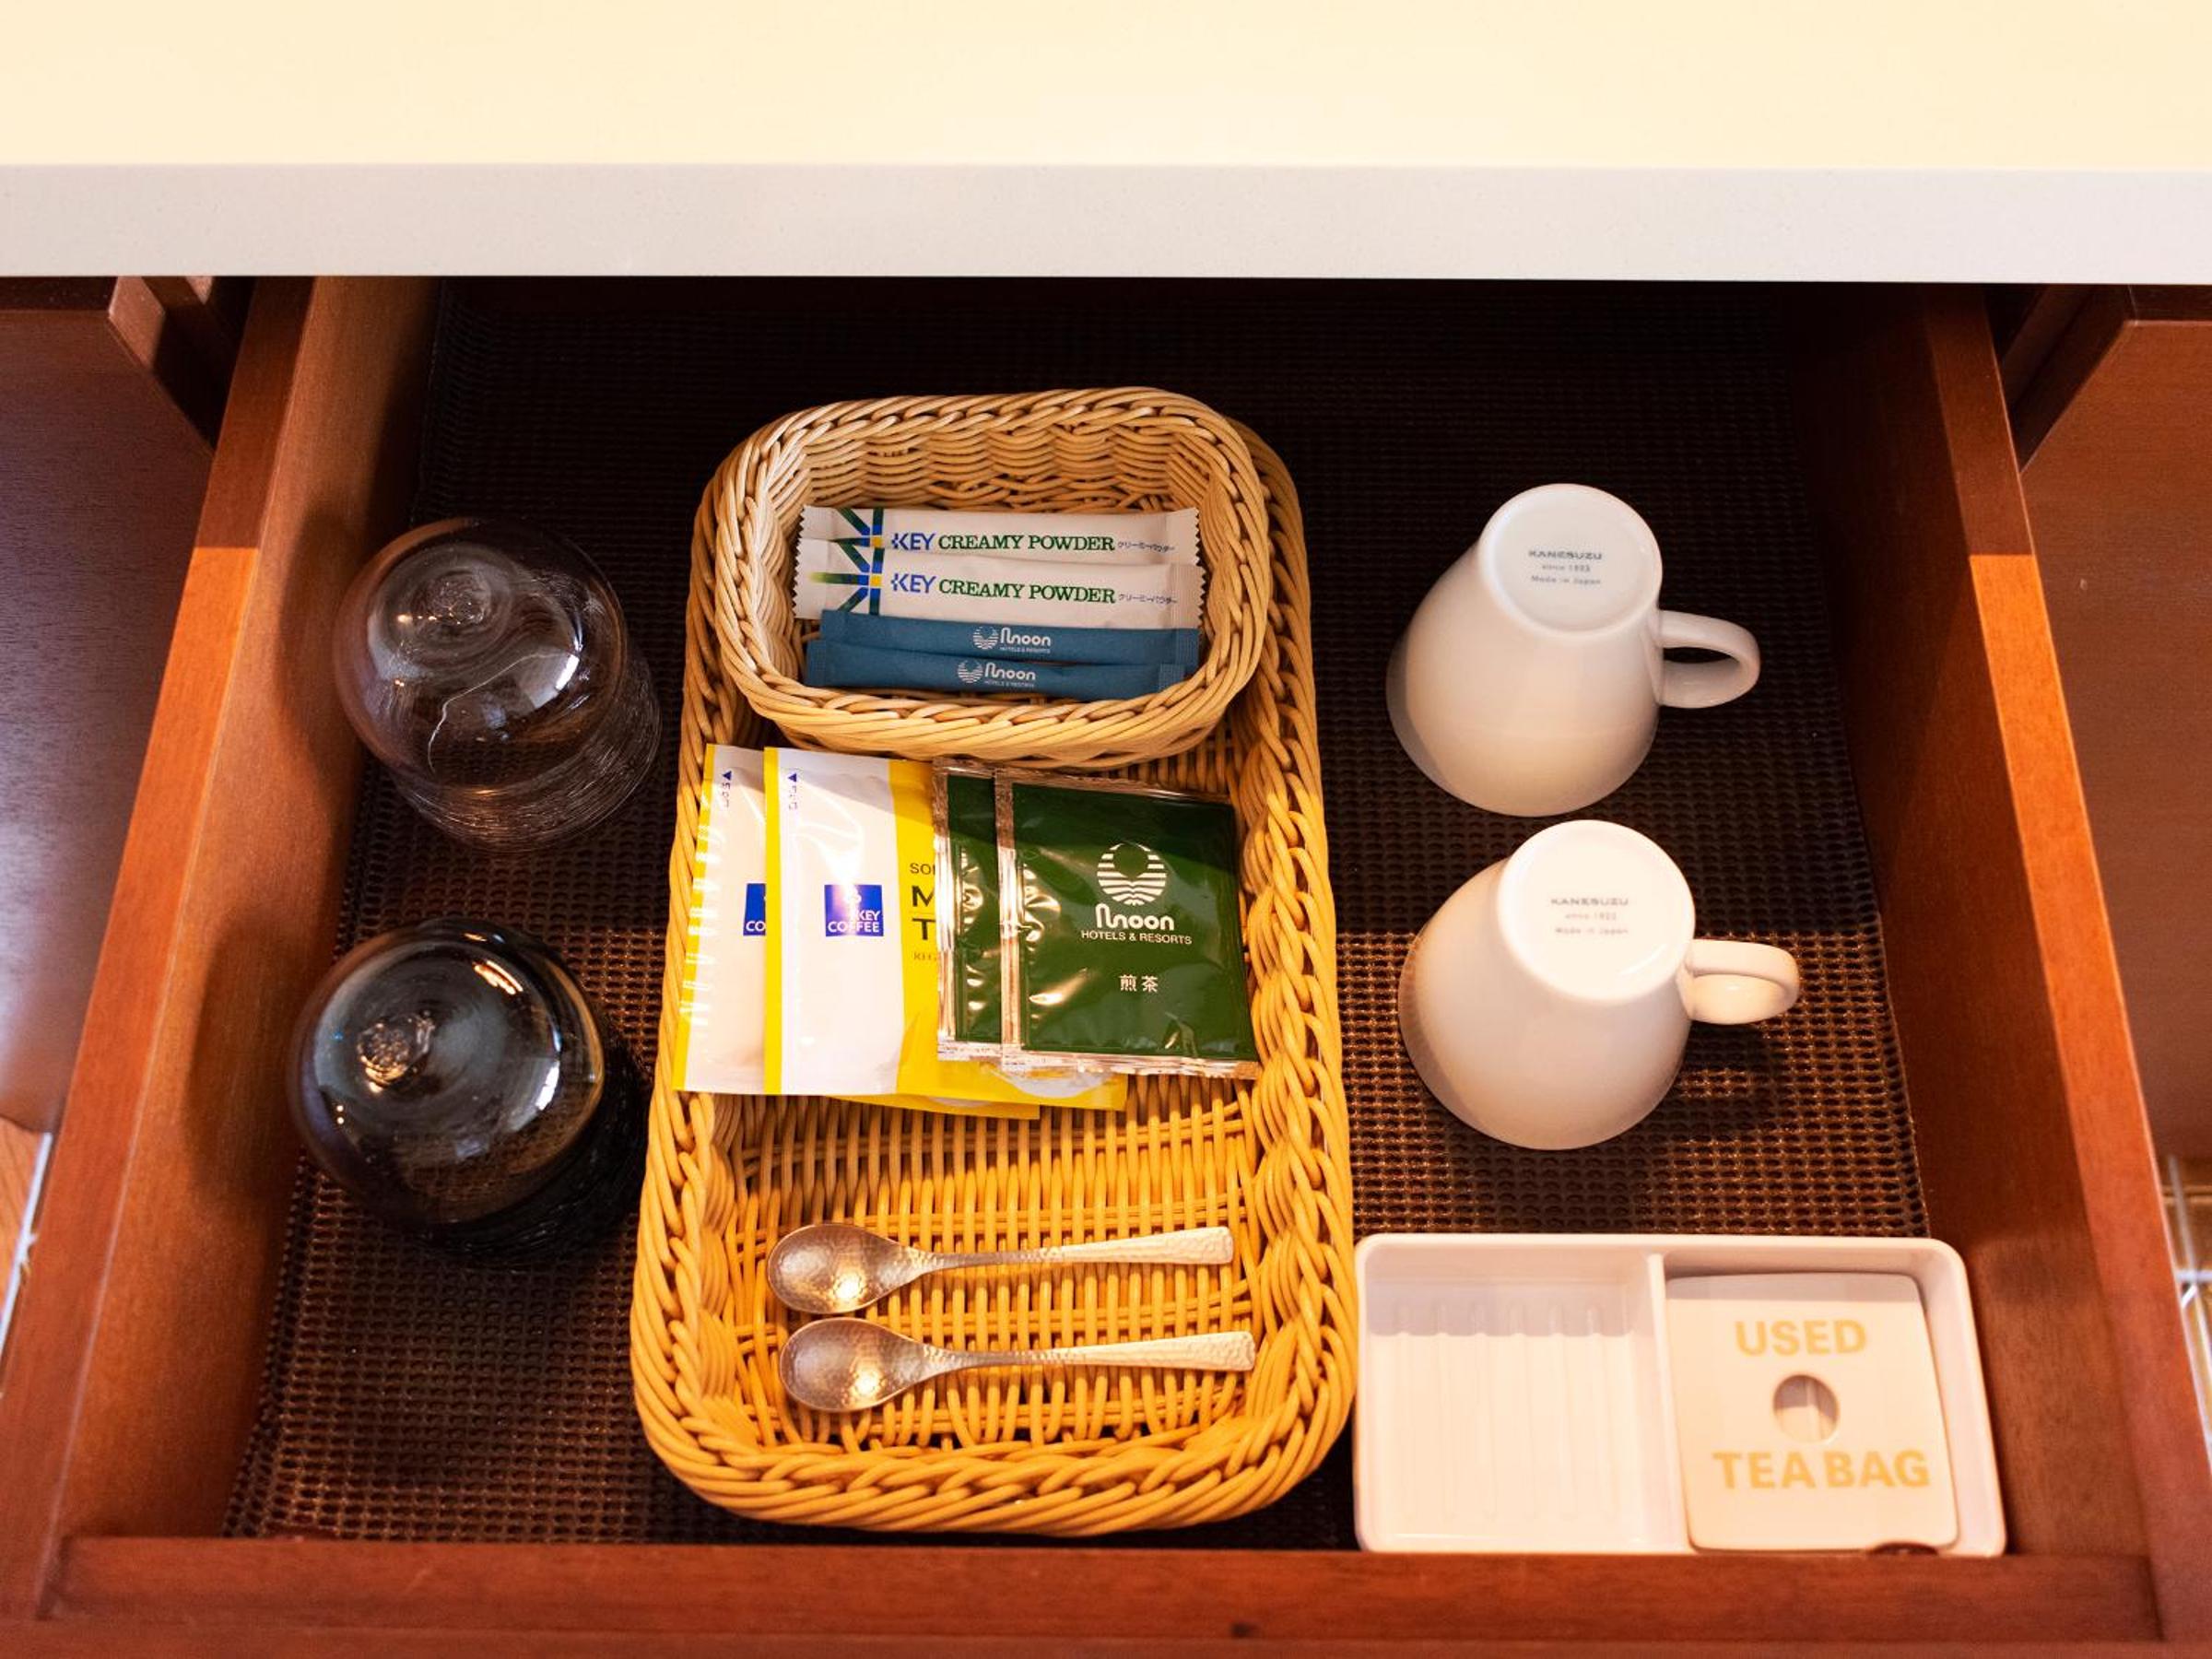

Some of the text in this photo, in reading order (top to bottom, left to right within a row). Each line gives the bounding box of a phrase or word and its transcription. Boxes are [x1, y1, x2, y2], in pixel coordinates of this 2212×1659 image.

[890, 533, 1115, 551] KEY CREAMY POWDER
[1531, 575, 1557, 583] Made
[890, 573, 1115, 604] KEY CREAMY POWDER
[910, 862, 935, 875] SO
[1550, 898, 1629, 906] KANESUZU
[1081, 930, 1193, 945] HOTELS & RESORTS
[1555, 926, 1582, 935] Made
[1599, 927, 1629, 935] Japan
[1119, 973, 1159, 993] 煎茶
[1735, 1320, 1867, 1357] USED
[1712, 1449, 1930, 1489] TEA BAG
